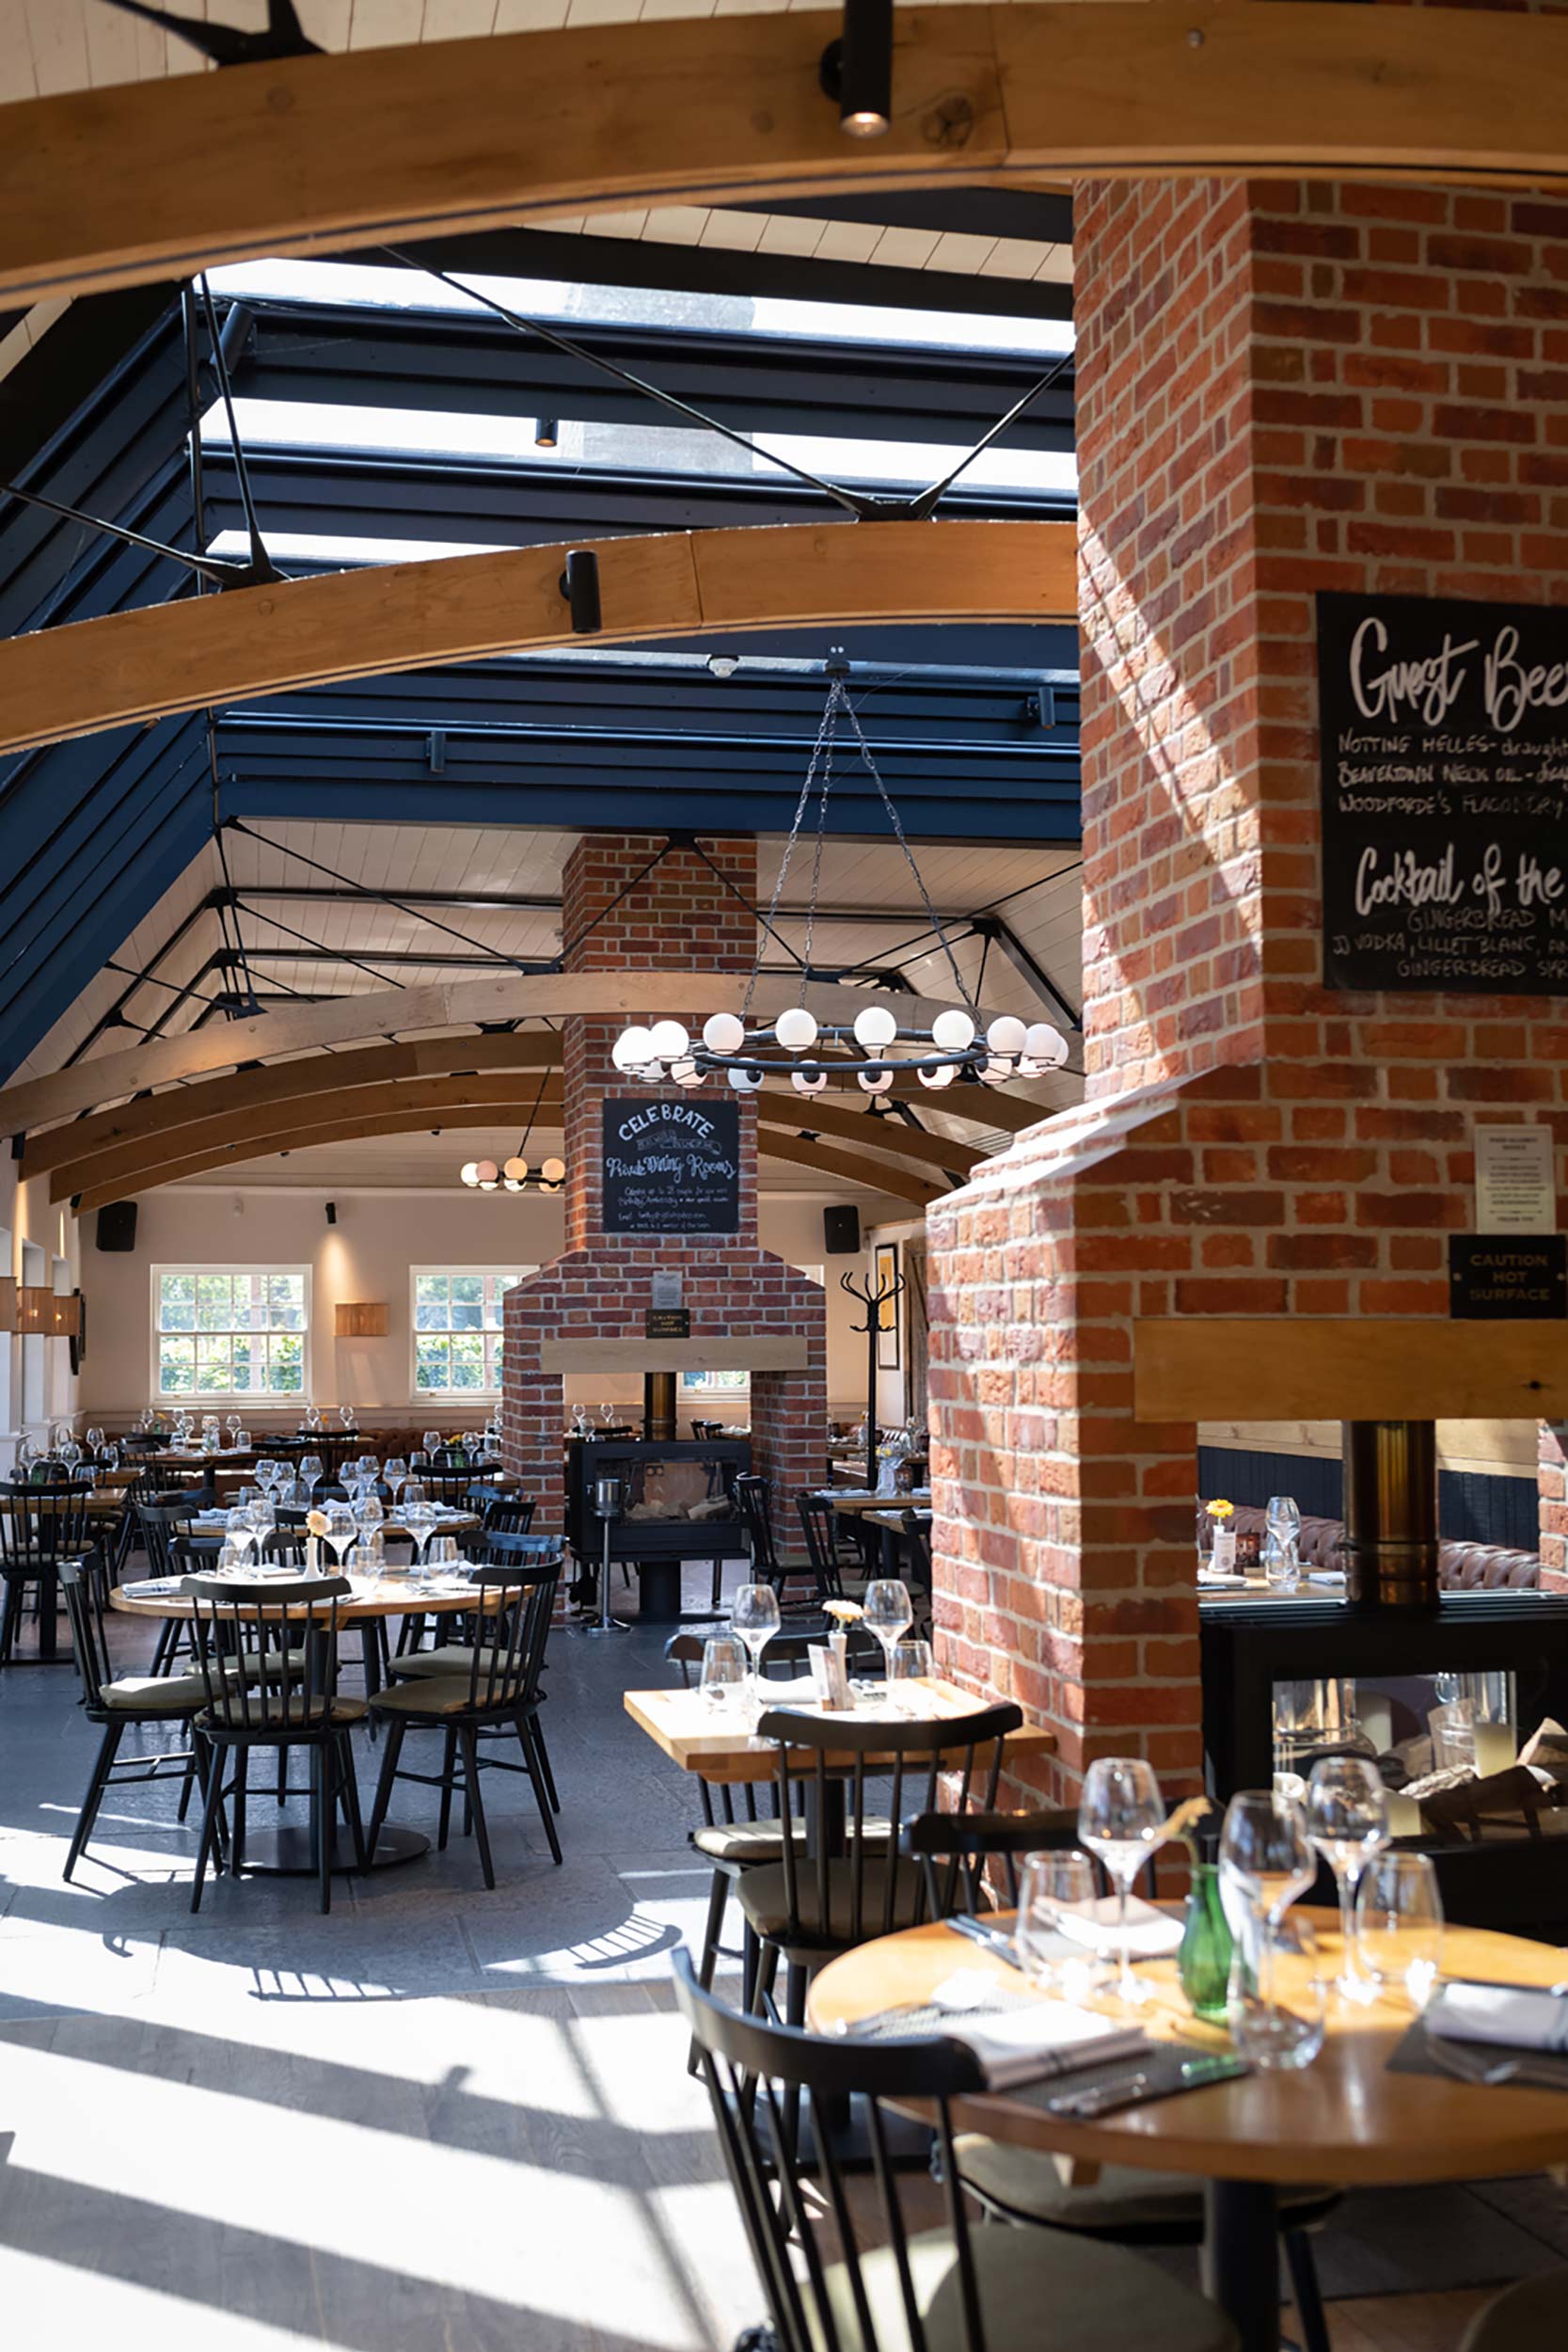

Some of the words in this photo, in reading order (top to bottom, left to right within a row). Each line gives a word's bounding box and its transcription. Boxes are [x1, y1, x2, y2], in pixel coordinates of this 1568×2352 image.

[1350, 617, 1480, 726] Guest
[1484, 625, 1568, 732] Bee
[1338, 728, 1410, 753] NOTTING
[1442, 763, 1489, 782] NECK
[1355, 842, 1464, 915] Cocktail
[1472, 843, 1507, 916] of
[1516, 853, 1565, 906] the
[618, 1104, 715, 1141] CELEBRATE
[1469, 1254, 1548, 1266] CAUTION
[1493, 1271, 1528, 1283] HOT
[1469, 1288, 1550, 1301] SURFACE
